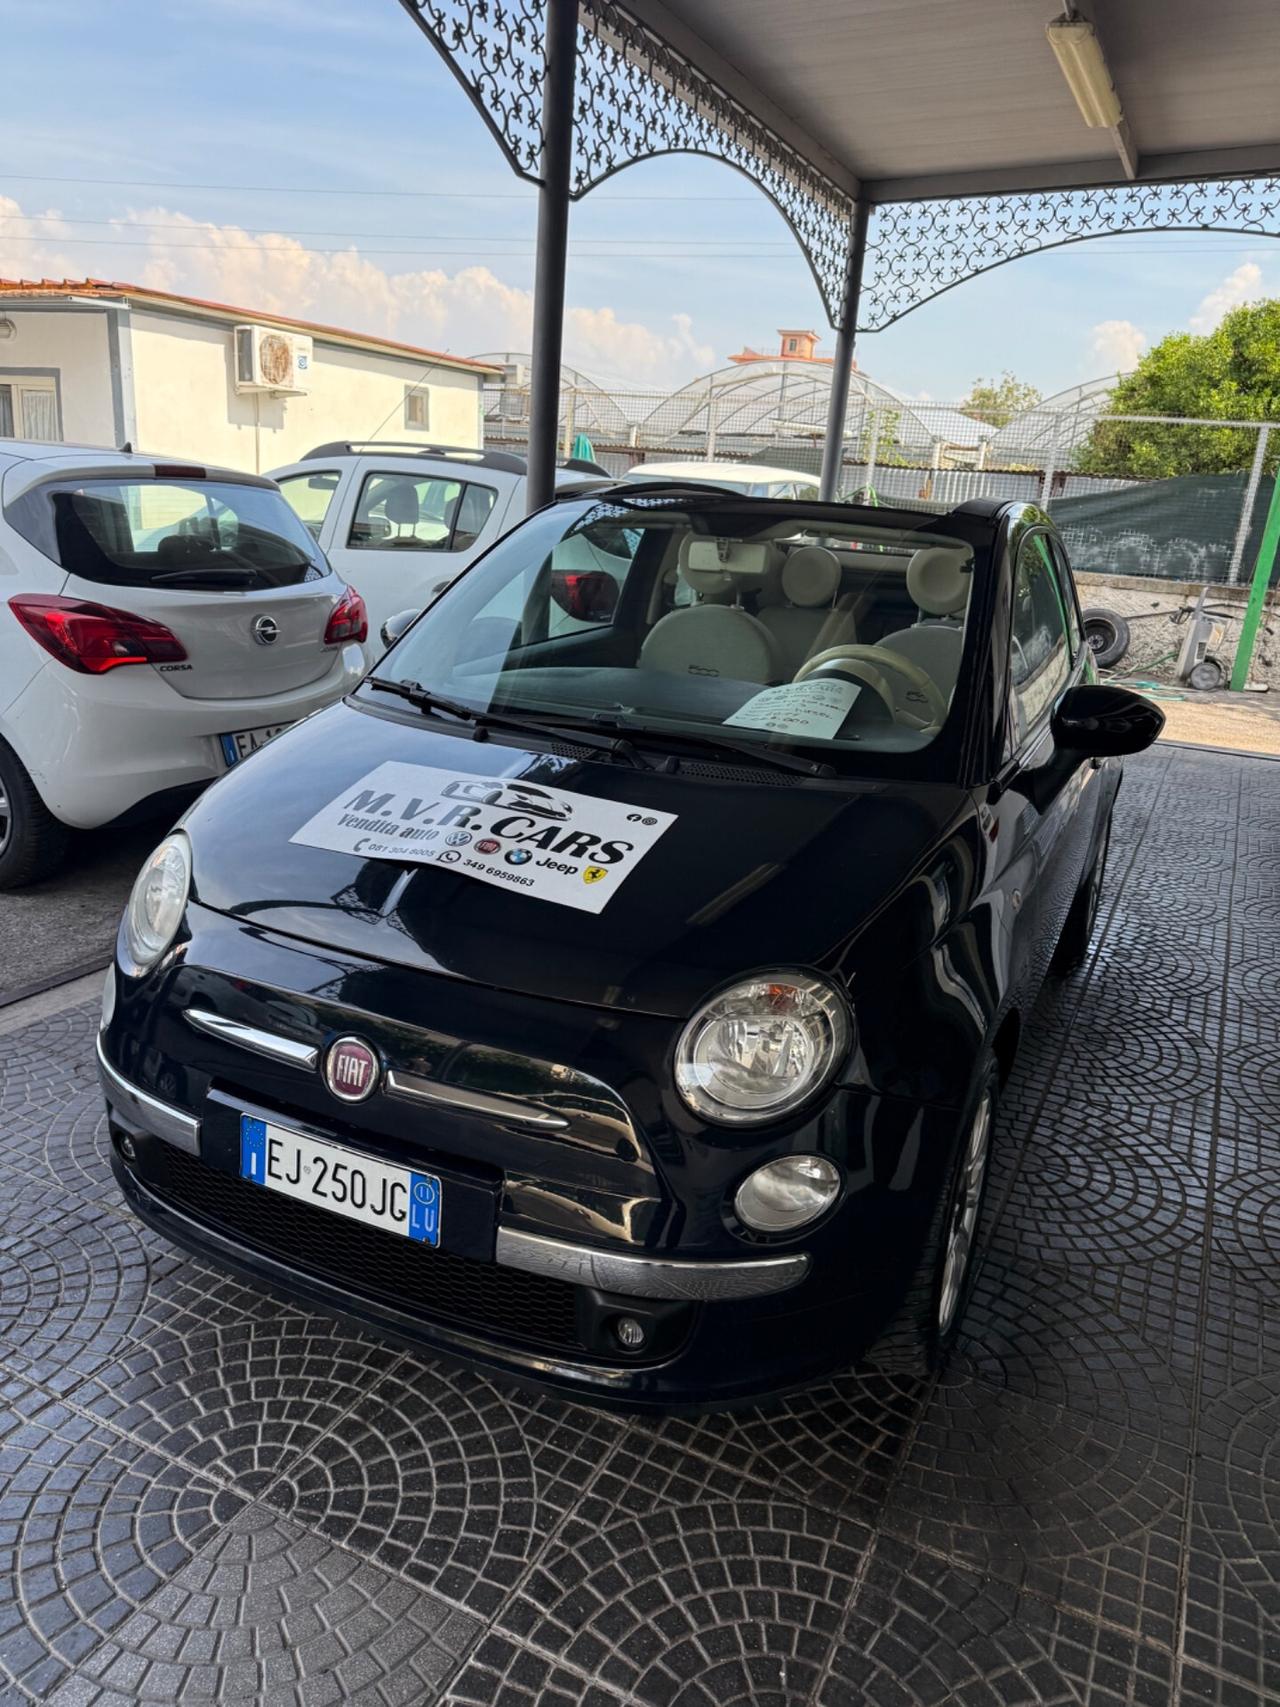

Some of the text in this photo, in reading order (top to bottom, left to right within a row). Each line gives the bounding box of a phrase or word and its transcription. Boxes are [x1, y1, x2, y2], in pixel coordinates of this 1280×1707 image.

[160, 664, 193, 672] CORSA
[338, 814, 440, 841] Vendita auto
[463, 859, 536, 887] 349 6959863
[536, 857, 578, 876] Jeep
[336, 1054, 368, 1088] FIAT
[411, 1204, 435, 1232] LU
